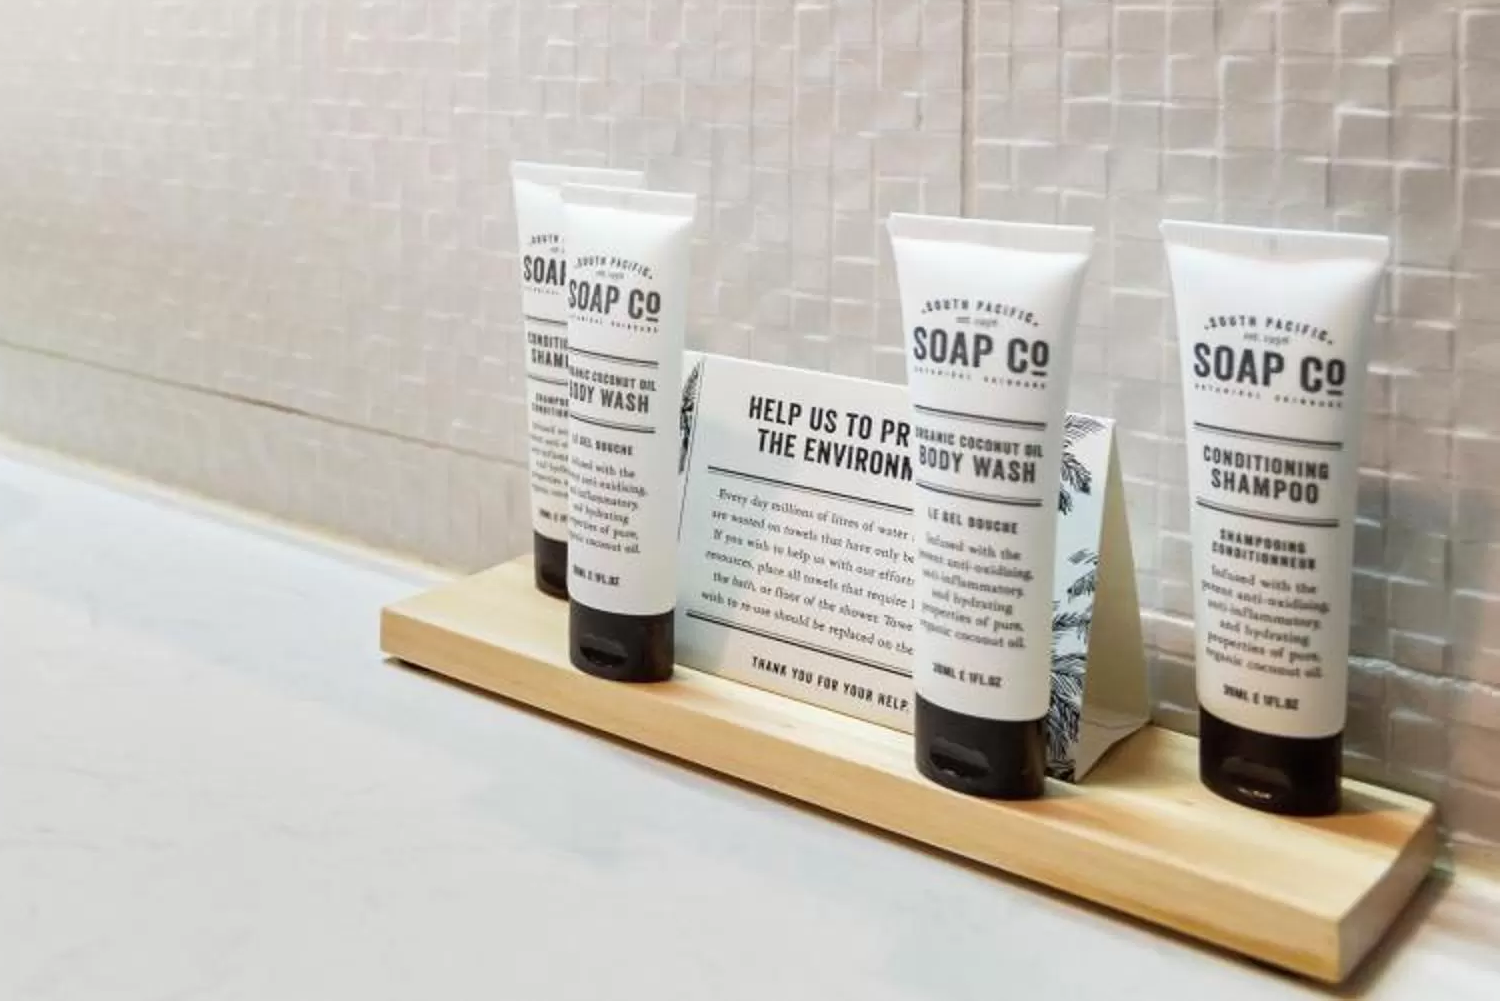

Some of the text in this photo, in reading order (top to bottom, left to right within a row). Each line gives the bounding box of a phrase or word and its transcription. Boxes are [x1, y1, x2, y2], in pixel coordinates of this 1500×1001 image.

[568, 279, 620, 314] SOAP
[925, 298, 970, 313] SOUTH
[976, 300, 1034, 325] PACIFIC
[1208, 314, 1258, 329] SOUTH
[1265, 316, 1329, 342] PACIFIC
[531, 348, 568, 368] SHAM
[913, 326, 994, 369] SOAP
[592, 370, 636, 389] COCONUT
[1193, 341, 1286, 388] SOAP
[600, 388, 649, 414] WASH
[749, 395, 803, 427] HELP
[809, 406, 838, 434] US
[846, 412, 873, 441] TO
[757, 428, 797, 459] THE
[959, 435, 1021, 457] COCONUT
[1025, 444, 1044, 459] OIL
[919, 444, 1037, 485] BODY WASH
[1203, 445, 1330, 481] CONDITIONING
[1211, 468, 1320, 505] SHAMPOO
[750, 494, 769, 512] day
[771, 502, 815, 519] millions
[816, 509, 831, 523] of
[862, 519, 875, 533] of
[877, 525, 909, 541] water
[967, 516, 1019, 536] DOUCHE
[730, 514, 765, 529] wasted
[767, 522, 781, 533] on
[783, 525, 818, 541] towels
[821, 532, 842, 548] that
[874, 546, 900, 564] only
[968, 545, 997, 559] with
[1001, 547, 1022, 561] the
[1212, 540, 1316, 571] CONDITIONNEUR
[1220, 528, 1307, 555] SHAMPOOING
[747, 539, 771, 552] wish
[773, 544, 784, 556] to
[787, 545, 811, 565] help
[813, 554, 826, 565] us
[829, 559, 853, 573] with
[855, 566, 876, 578] our
[757, 562, 785, 577] place
[787, 568, 802, 582] all
[803, 574, 839, 591] towels
[841, 582, 864, 597] that
[867, 590, 908, 608] require
[1260, 580, 1292, 593] with
[1295, 582, 1317, 595] the
[713, 572, 730, 585] the
[760, 585, 773, 597] or
[774, 585, 801, 604] floor
[803, 595, 816, 608] of
[818, 598, 836, 613] the
[883, 614, 913, 633] Towe
[701, 591, 725, 605] wish
[727, 598, 739, 608] to
[774, 608, 811, 628] should
[812, 618, 826, 632] be
[828, 625, 875, 647] replaced
[878, 638, 893, 651] on
[895, 640, 915, 657] the
[1219, 619, 1241, 633] and
[1269, 646, 1285, 659] of
[752, 655, 788, 678] THANK
[791, 666, 814, 686] YOU
[818, 674, 840, 693] FOR
[843, 681, 874, 702] YOUR
